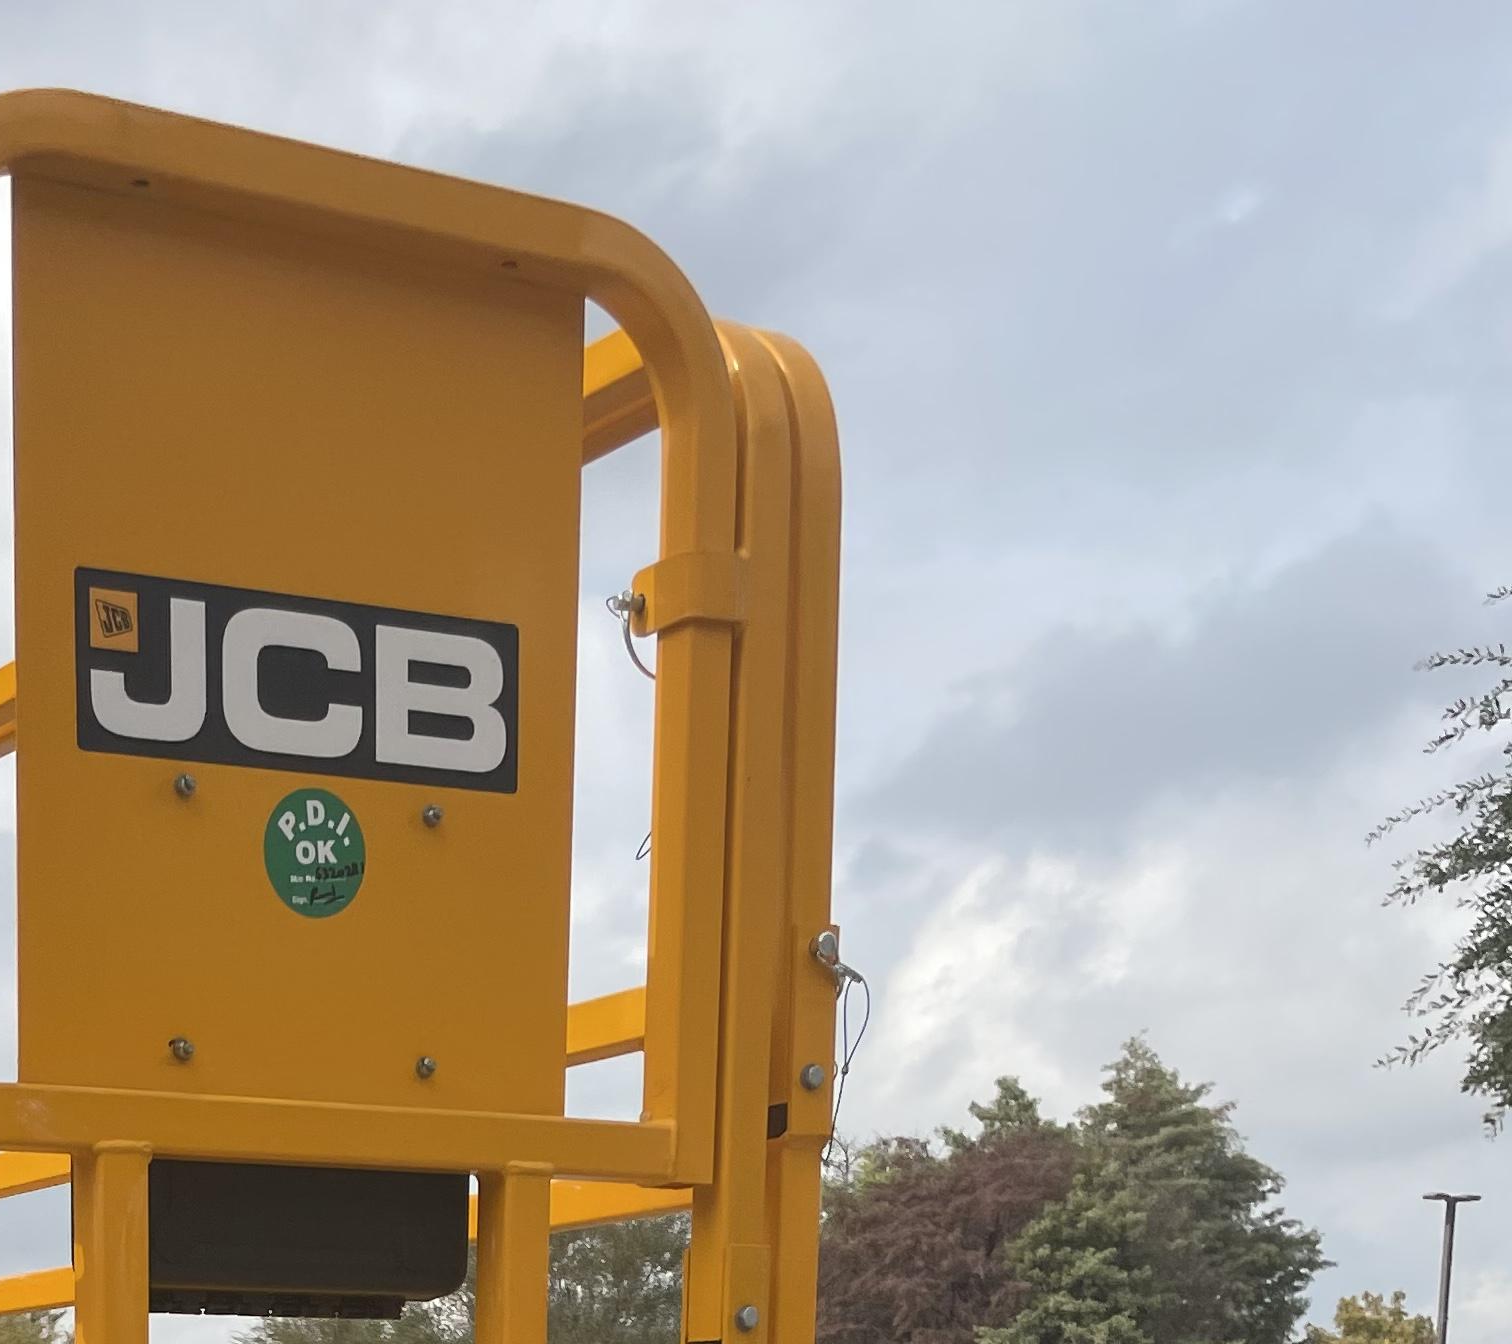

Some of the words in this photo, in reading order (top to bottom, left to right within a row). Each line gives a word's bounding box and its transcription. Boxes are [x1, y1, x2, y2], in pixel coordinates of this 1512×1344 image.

[90, 597, 507, 773] JCB
[278, 799, 351, 847] P.D.I.
[295, 840, 338, 865] OK
